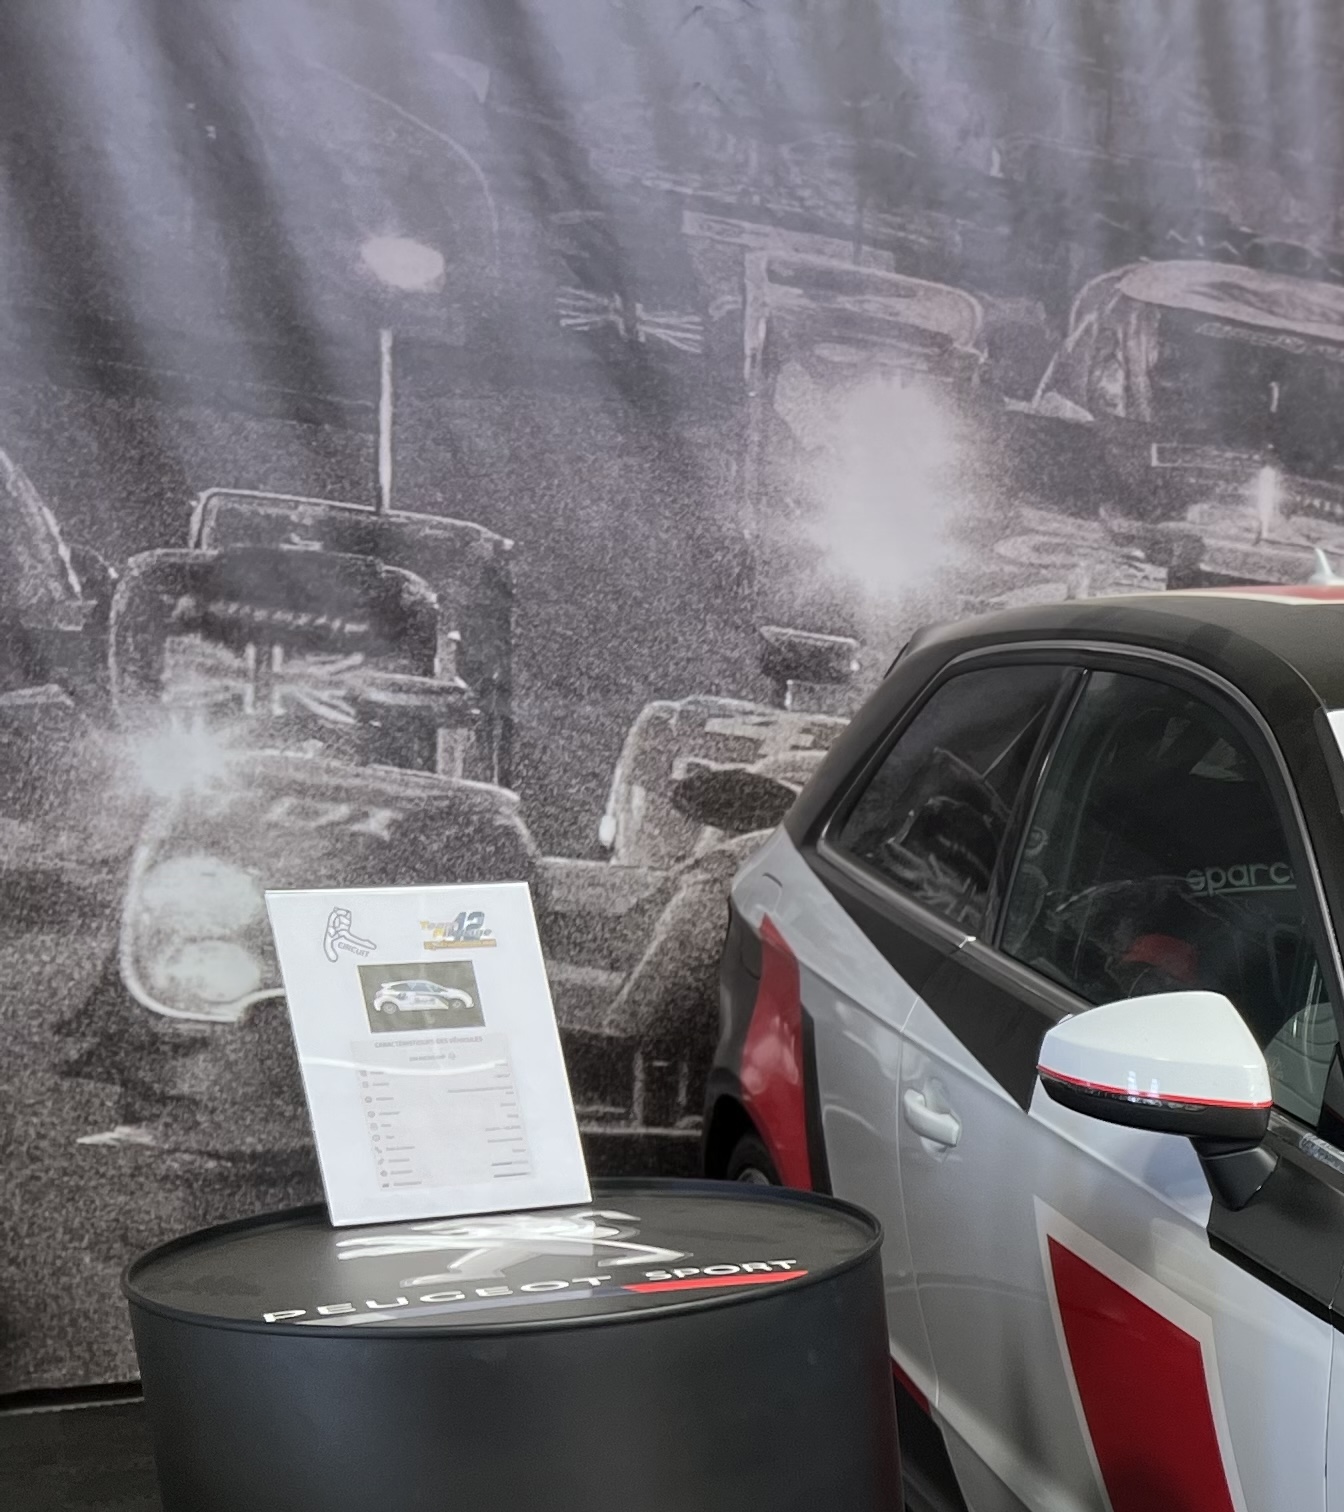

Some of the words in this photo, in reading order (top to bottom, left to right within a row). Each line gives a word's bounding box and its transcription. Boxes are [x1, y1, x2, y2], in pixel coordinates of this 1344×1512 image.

[1186, 862, 1294, 897] sparc
[337, 941, 370, 958] CIRCUIT
[262, 1274, 611, 1323] PEUGEOT
[645, 1258, 798, 1281] SPORT
